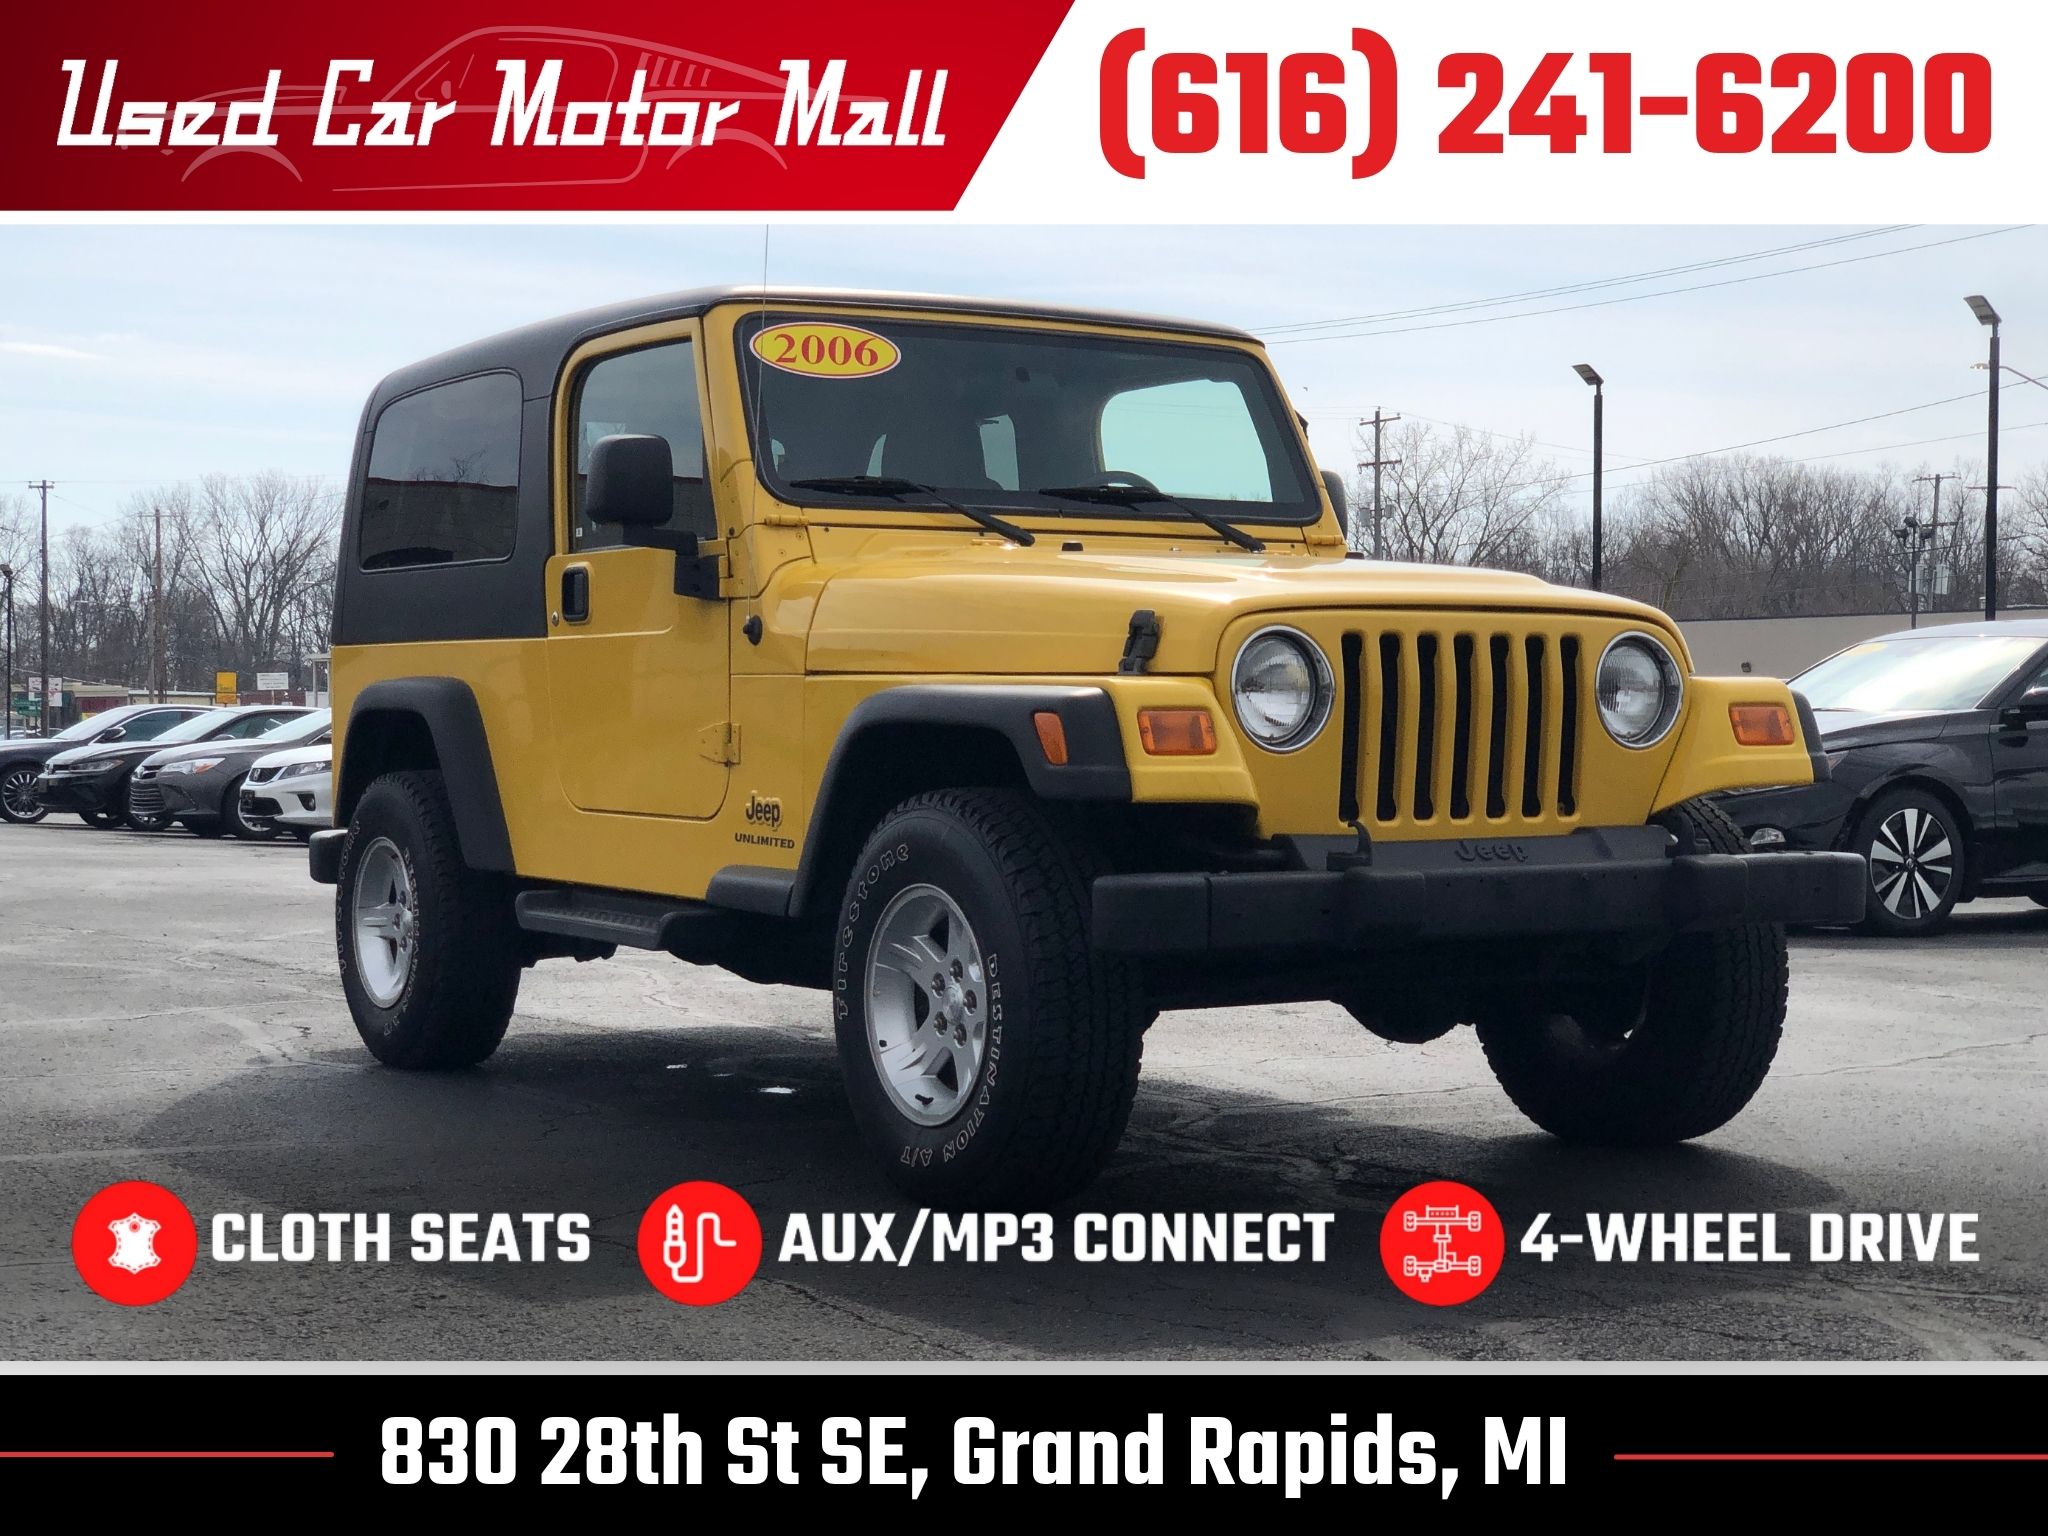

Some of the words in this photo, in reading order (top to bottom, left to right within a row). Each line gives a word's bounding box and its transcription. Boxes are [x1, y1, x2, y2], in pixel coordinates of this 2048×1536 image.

[774, 333, 879, 367] 2006
[745, 792, 782, 830] Jeep
[734, 832, 796, 849] UNLIMITED
[1453, 840, 1529, 863] Jeep
[943, 952, 1003, 1164] DESTINATION
